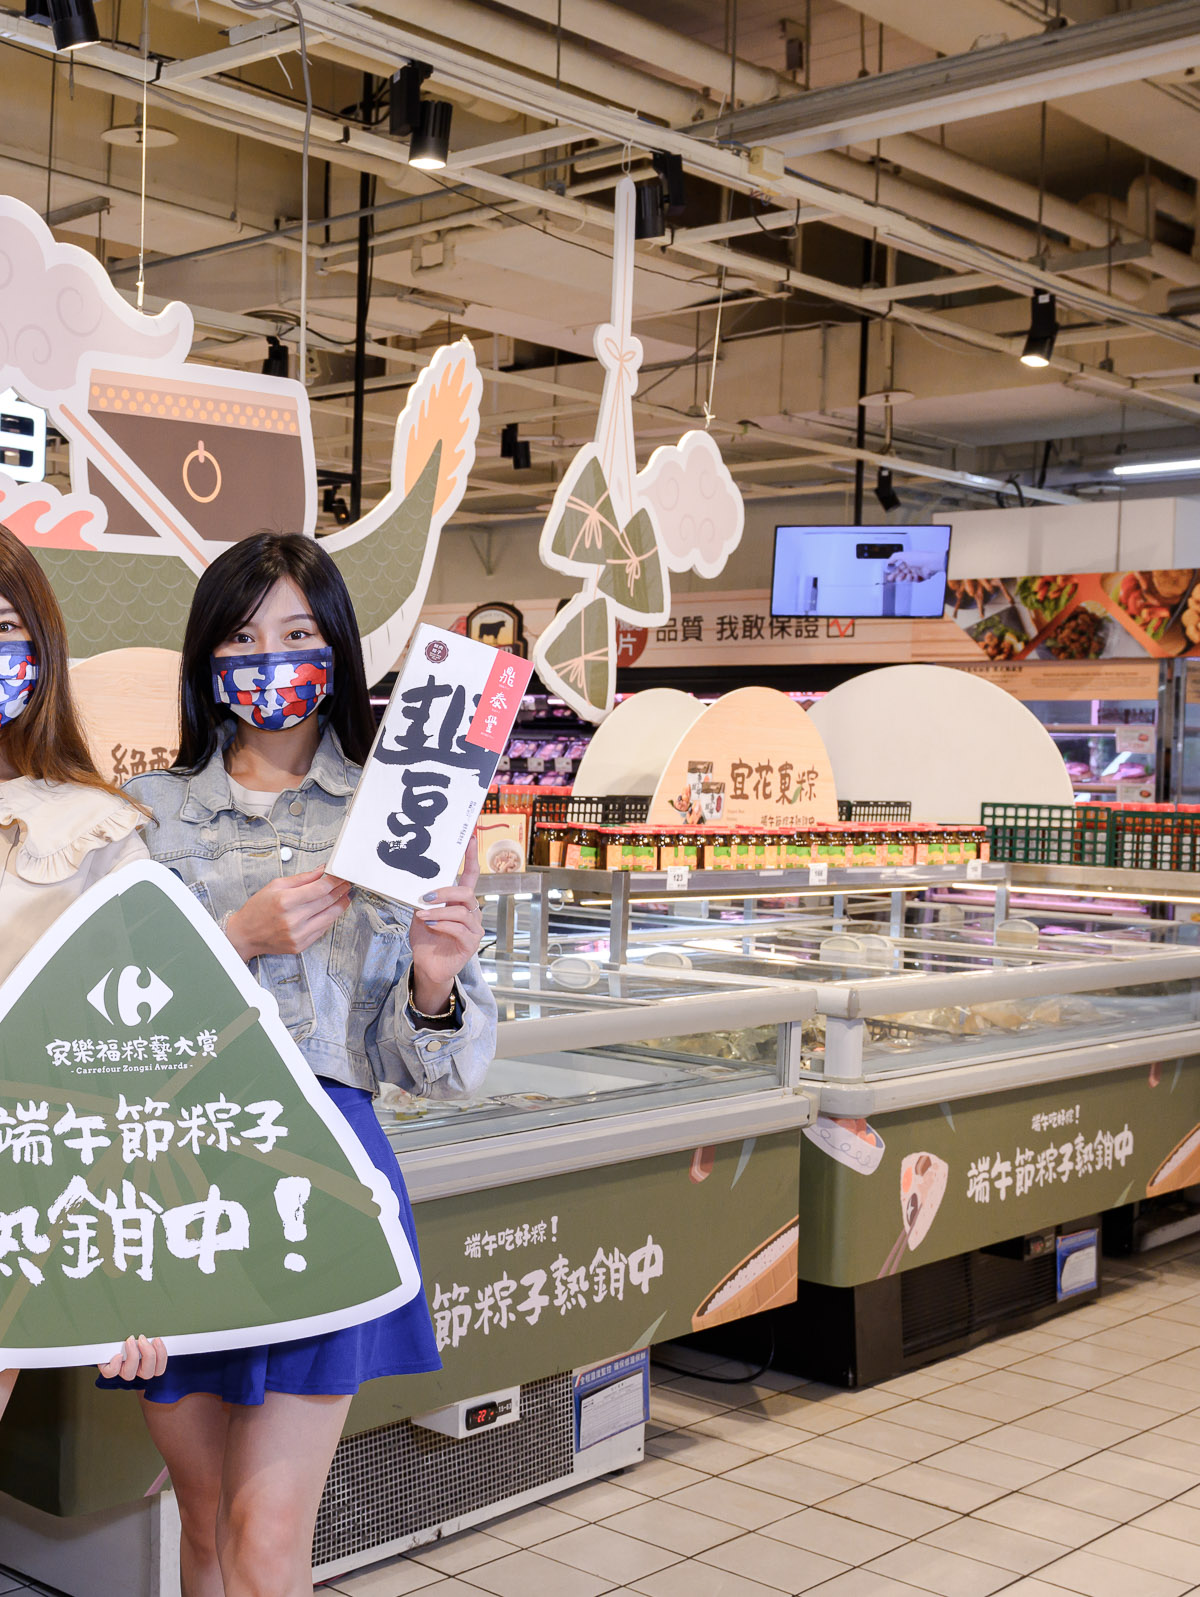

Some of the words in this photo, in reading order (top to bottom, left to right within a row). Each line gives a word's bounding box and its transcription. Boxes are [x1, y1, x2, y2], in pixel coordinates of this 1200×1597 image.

[656, 616, 703, 643] 品質
[716, 614, 819, 642] 我敢保證
[484, 666, 516, 733] 鼎泰豐
[730, 758, 819, 805] 宜花東粽
[45, 1028, 218, 1067] 家樂福粽藝大賞
[76, 1065, 121, 1075] Carrefour
[122, 1064, 153, 1074] Zongzi
[154, 1062, 188, 1071] Awards
[966, 1123, 1133, 1204] 端午節粽子熱銷中
[432, 1235, 664, 1352] 節粽子熱銷中
